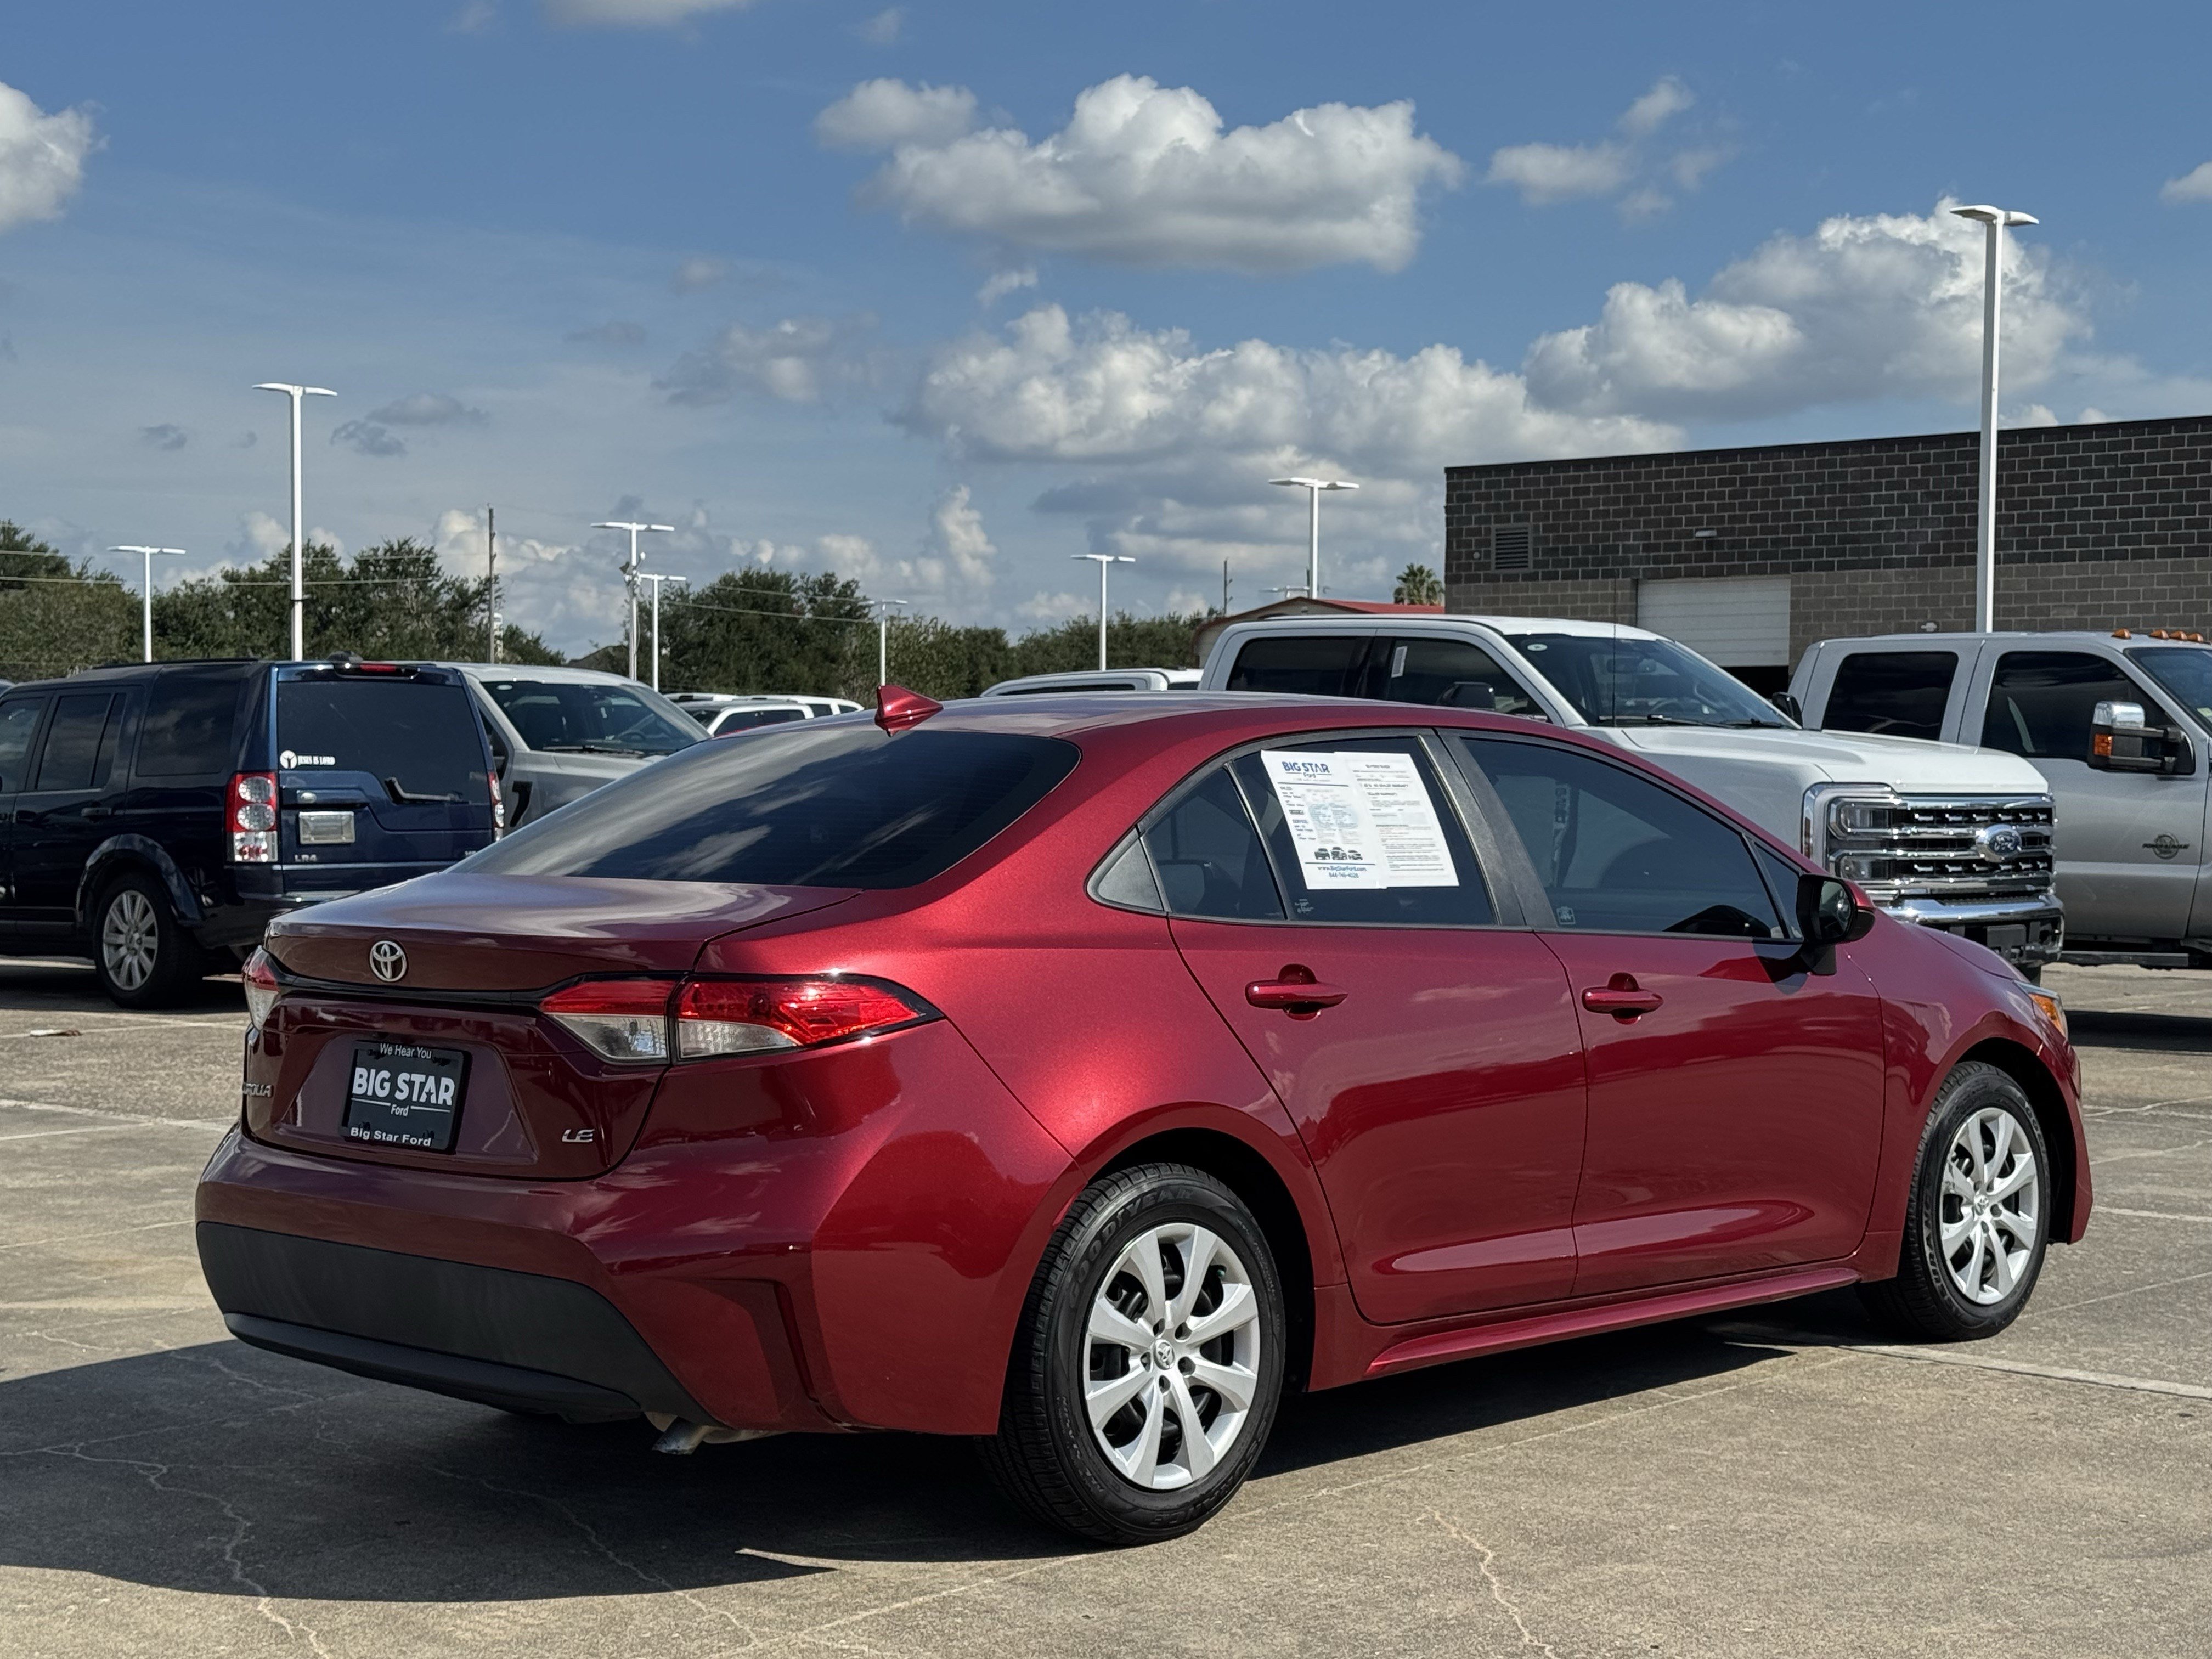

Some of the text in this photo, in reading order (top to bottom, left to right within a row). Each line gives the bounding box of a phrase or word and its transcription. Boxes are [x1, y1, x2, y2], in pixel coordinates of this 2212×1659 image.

[313, 755, 319, 765] IS
[319, 756, 336, 766] LORD
[1282, 761, 1330, 774] BIG STAR
[294, 854, 318, 862] LR4
[380, 1043, 432, 1059] We Hear You
[352, 1067, 455, 1106] BIG STAR
[390, 1104, 410, 1117] Ford
[350, 1126, 432, 1147] Big Star Ford
[562, 1129, 595, 1143] LE
[1070, 1189, 1194, 1308] GOODYEAR
